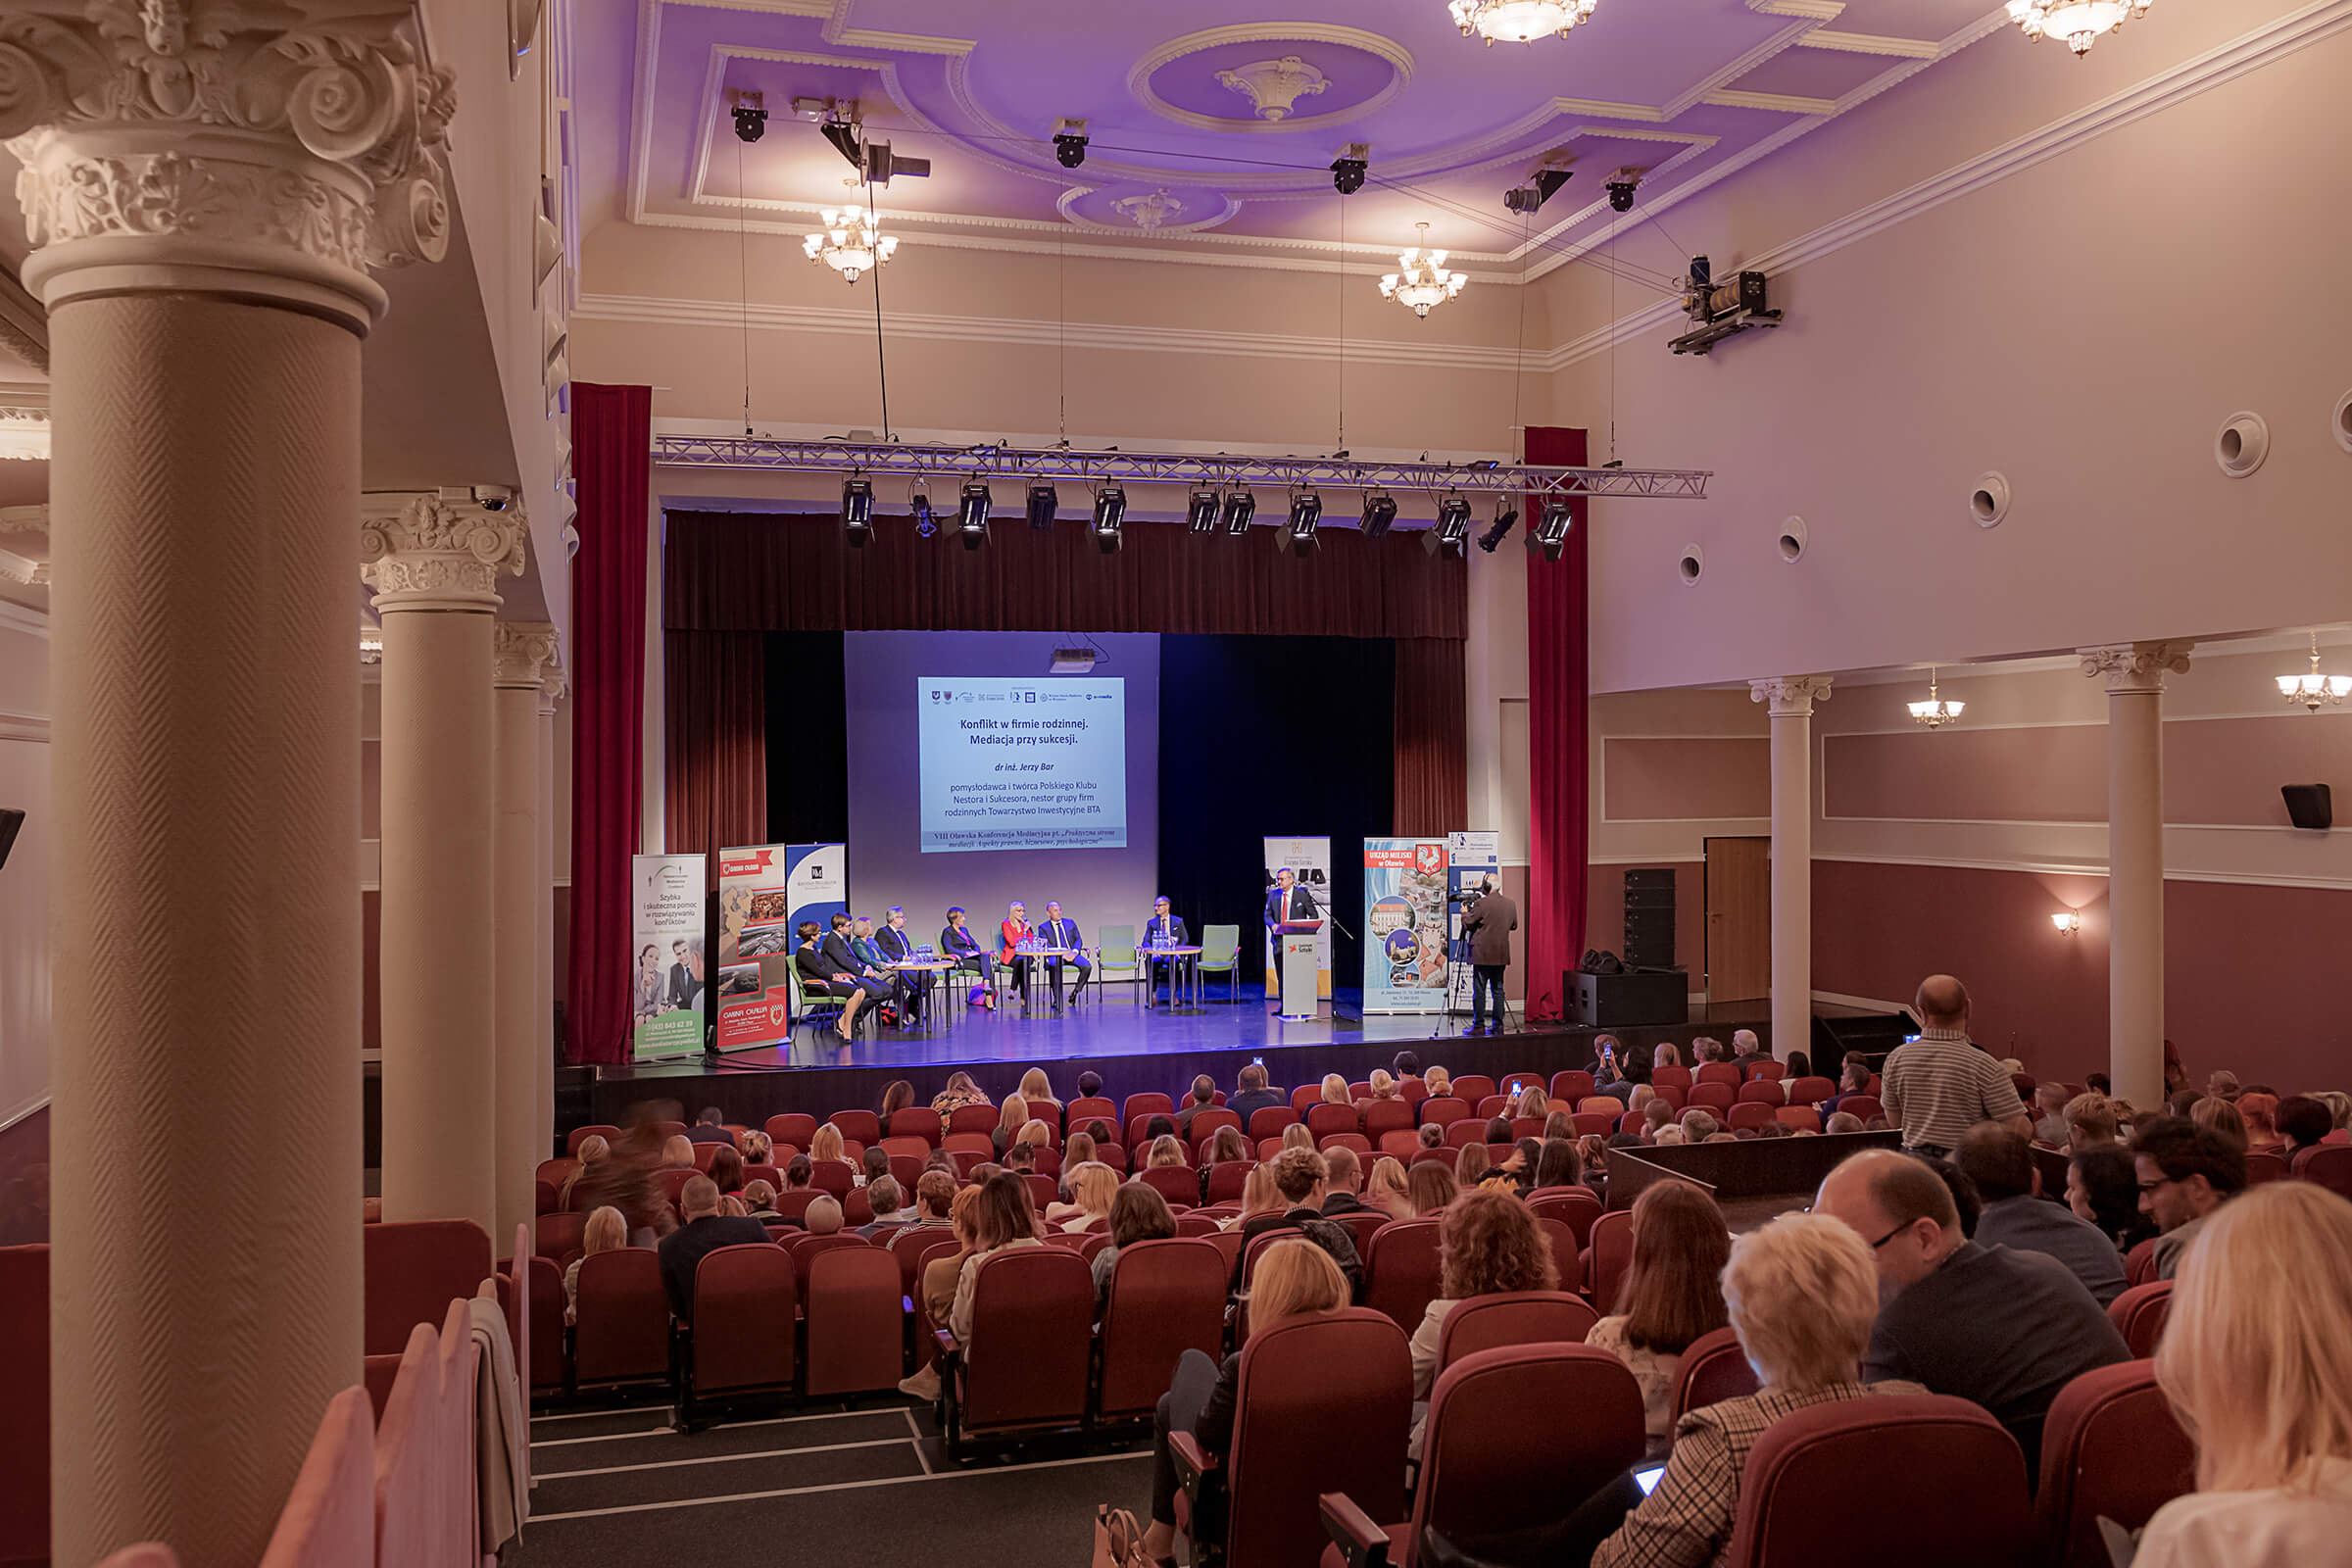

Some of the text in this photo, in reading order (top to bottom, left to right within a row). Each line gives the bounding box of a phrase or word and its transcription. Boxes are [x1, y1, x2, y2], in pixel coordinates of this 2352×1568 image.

[960, 718, 999, 730] Konflikt
[1011, 718, 1040, 729] firmie
[1042, 718, 1089, 730] rodzinnej.
[970, 734, 1078, 746] Mediacja przy sukcesji.
[995, 762, 1054, 772] dr inż. Jerzy Bar
[950, 783, 1007, 793] pomysłodawca
[1012, 782, 1038, 790] twórca
[1040, 781, 1075, 791] Polskiego
[1076, 781, 1097, 789] Klubu
[953, 796, 983, 804] Nestora
[989, 795, 1029, 804] Sukcesora,
[1056, 795, 1078, 804] grupy
[1078, 793, 1095, 801] firm
[945, 808, 986, 817] rodzinnych
[987, 807, 1036, 816] Towarzystwo
[1037, 806, 1085, 815] Inwestycyjne
[1370, 852, 1389, 860] URZĄD
